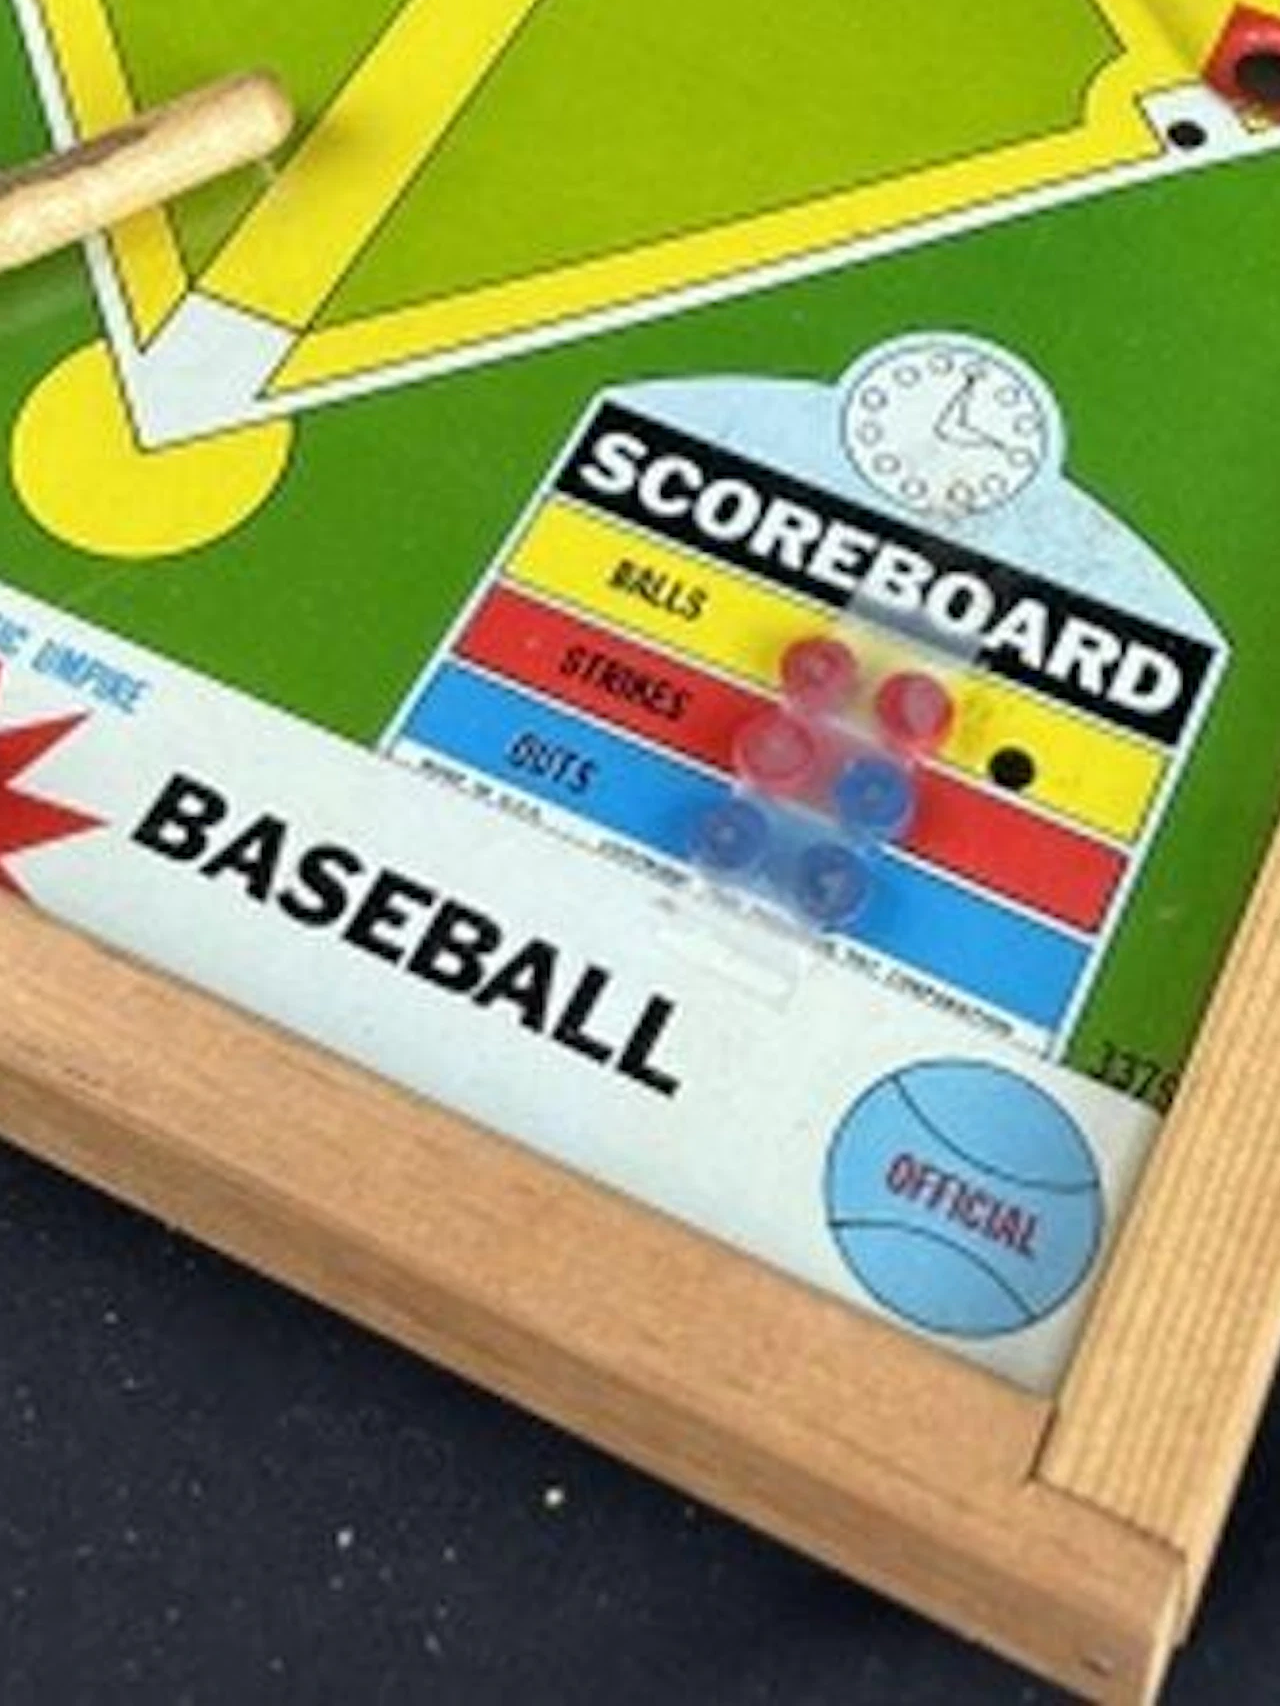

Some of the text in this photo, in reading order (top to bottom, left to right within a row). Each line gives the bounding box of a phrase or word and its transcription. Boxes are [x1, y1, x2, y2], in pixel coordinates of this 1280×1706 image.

[579, 430, 1184, 717] SCOREBOARD
[607, 557, 708, 622] BALLS
[30, 637, 154, 716] UMPIRE
[559, 643, 694, 721] STRIKES
[508, 730, 597, 795] OUTS
[129, 771, 685, 1097] BASEBALL
[884, 1151, 1044, 1261] OFFICIAL
